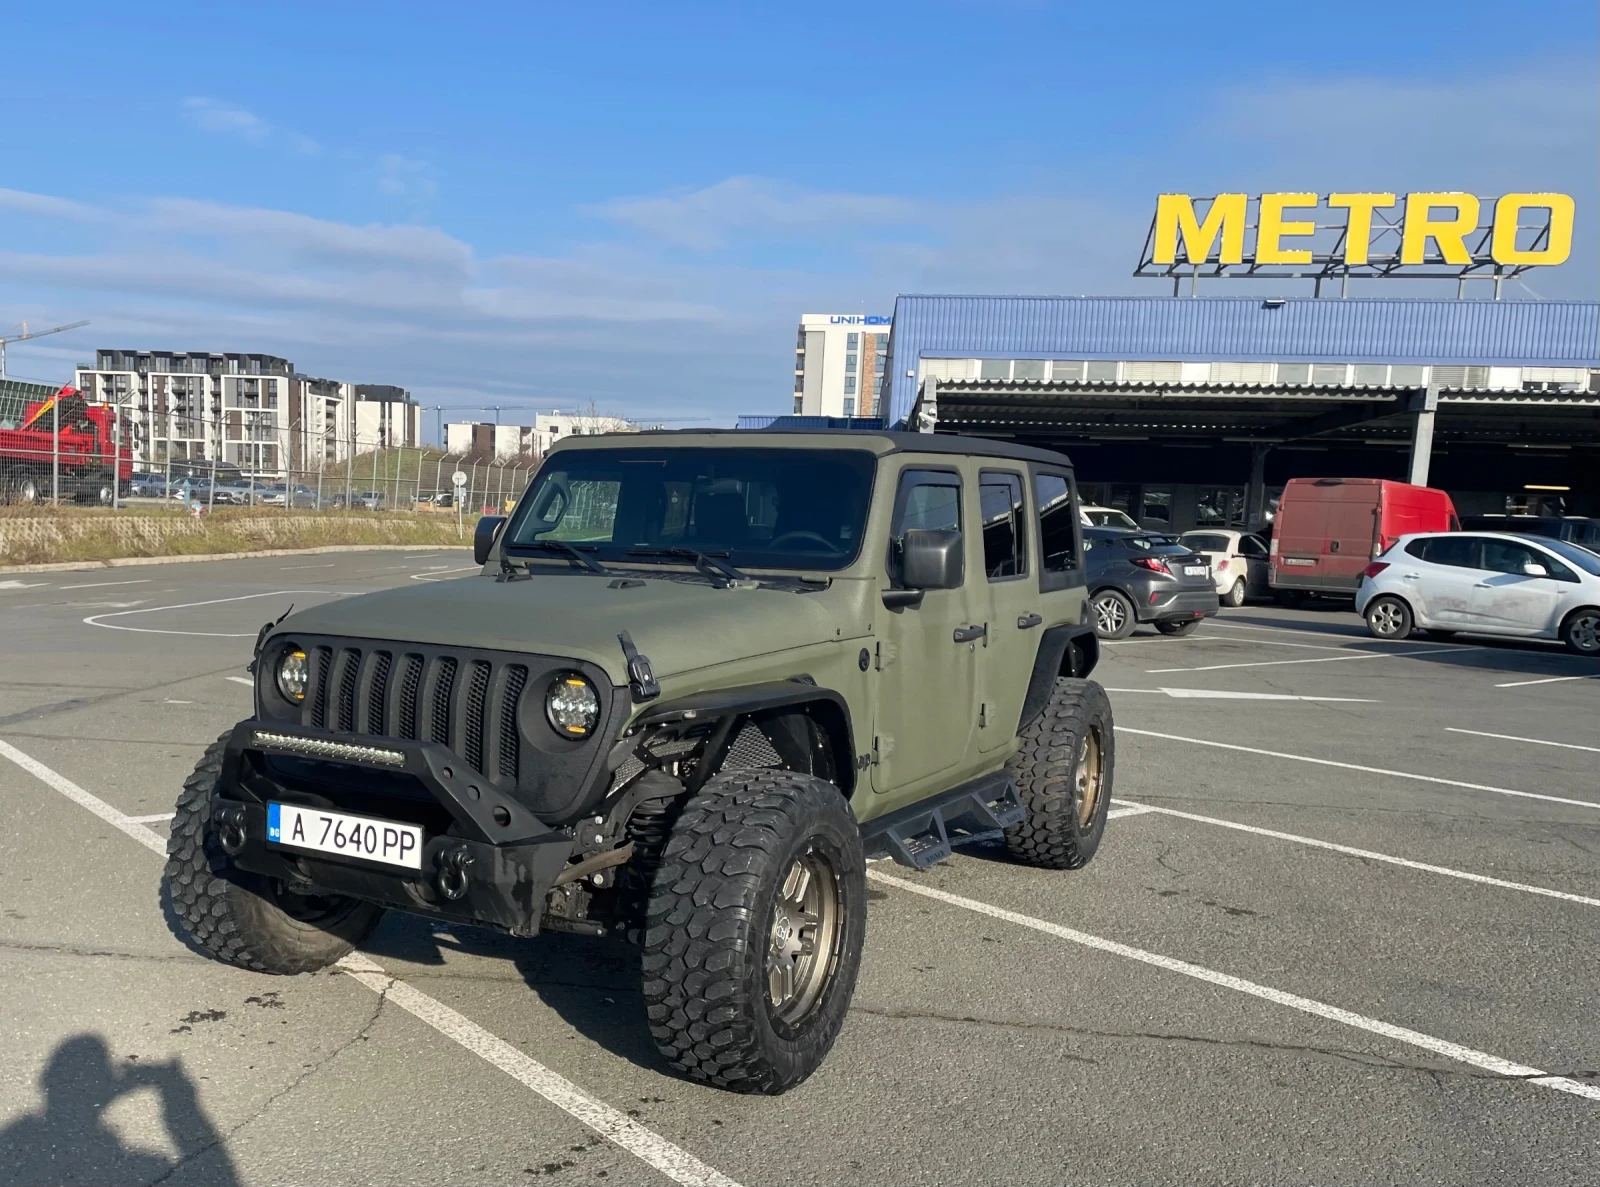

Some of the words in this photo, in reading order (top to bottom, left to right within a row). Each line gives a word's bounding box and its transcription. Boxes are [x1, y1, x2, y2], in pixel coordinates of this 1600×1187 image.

[1152, 193, 1576, 266] METRO
[830, 315, 892, 325] UNIHOM
[270, 827, 280, 837] BG
[292, 813, 305, 842] A
